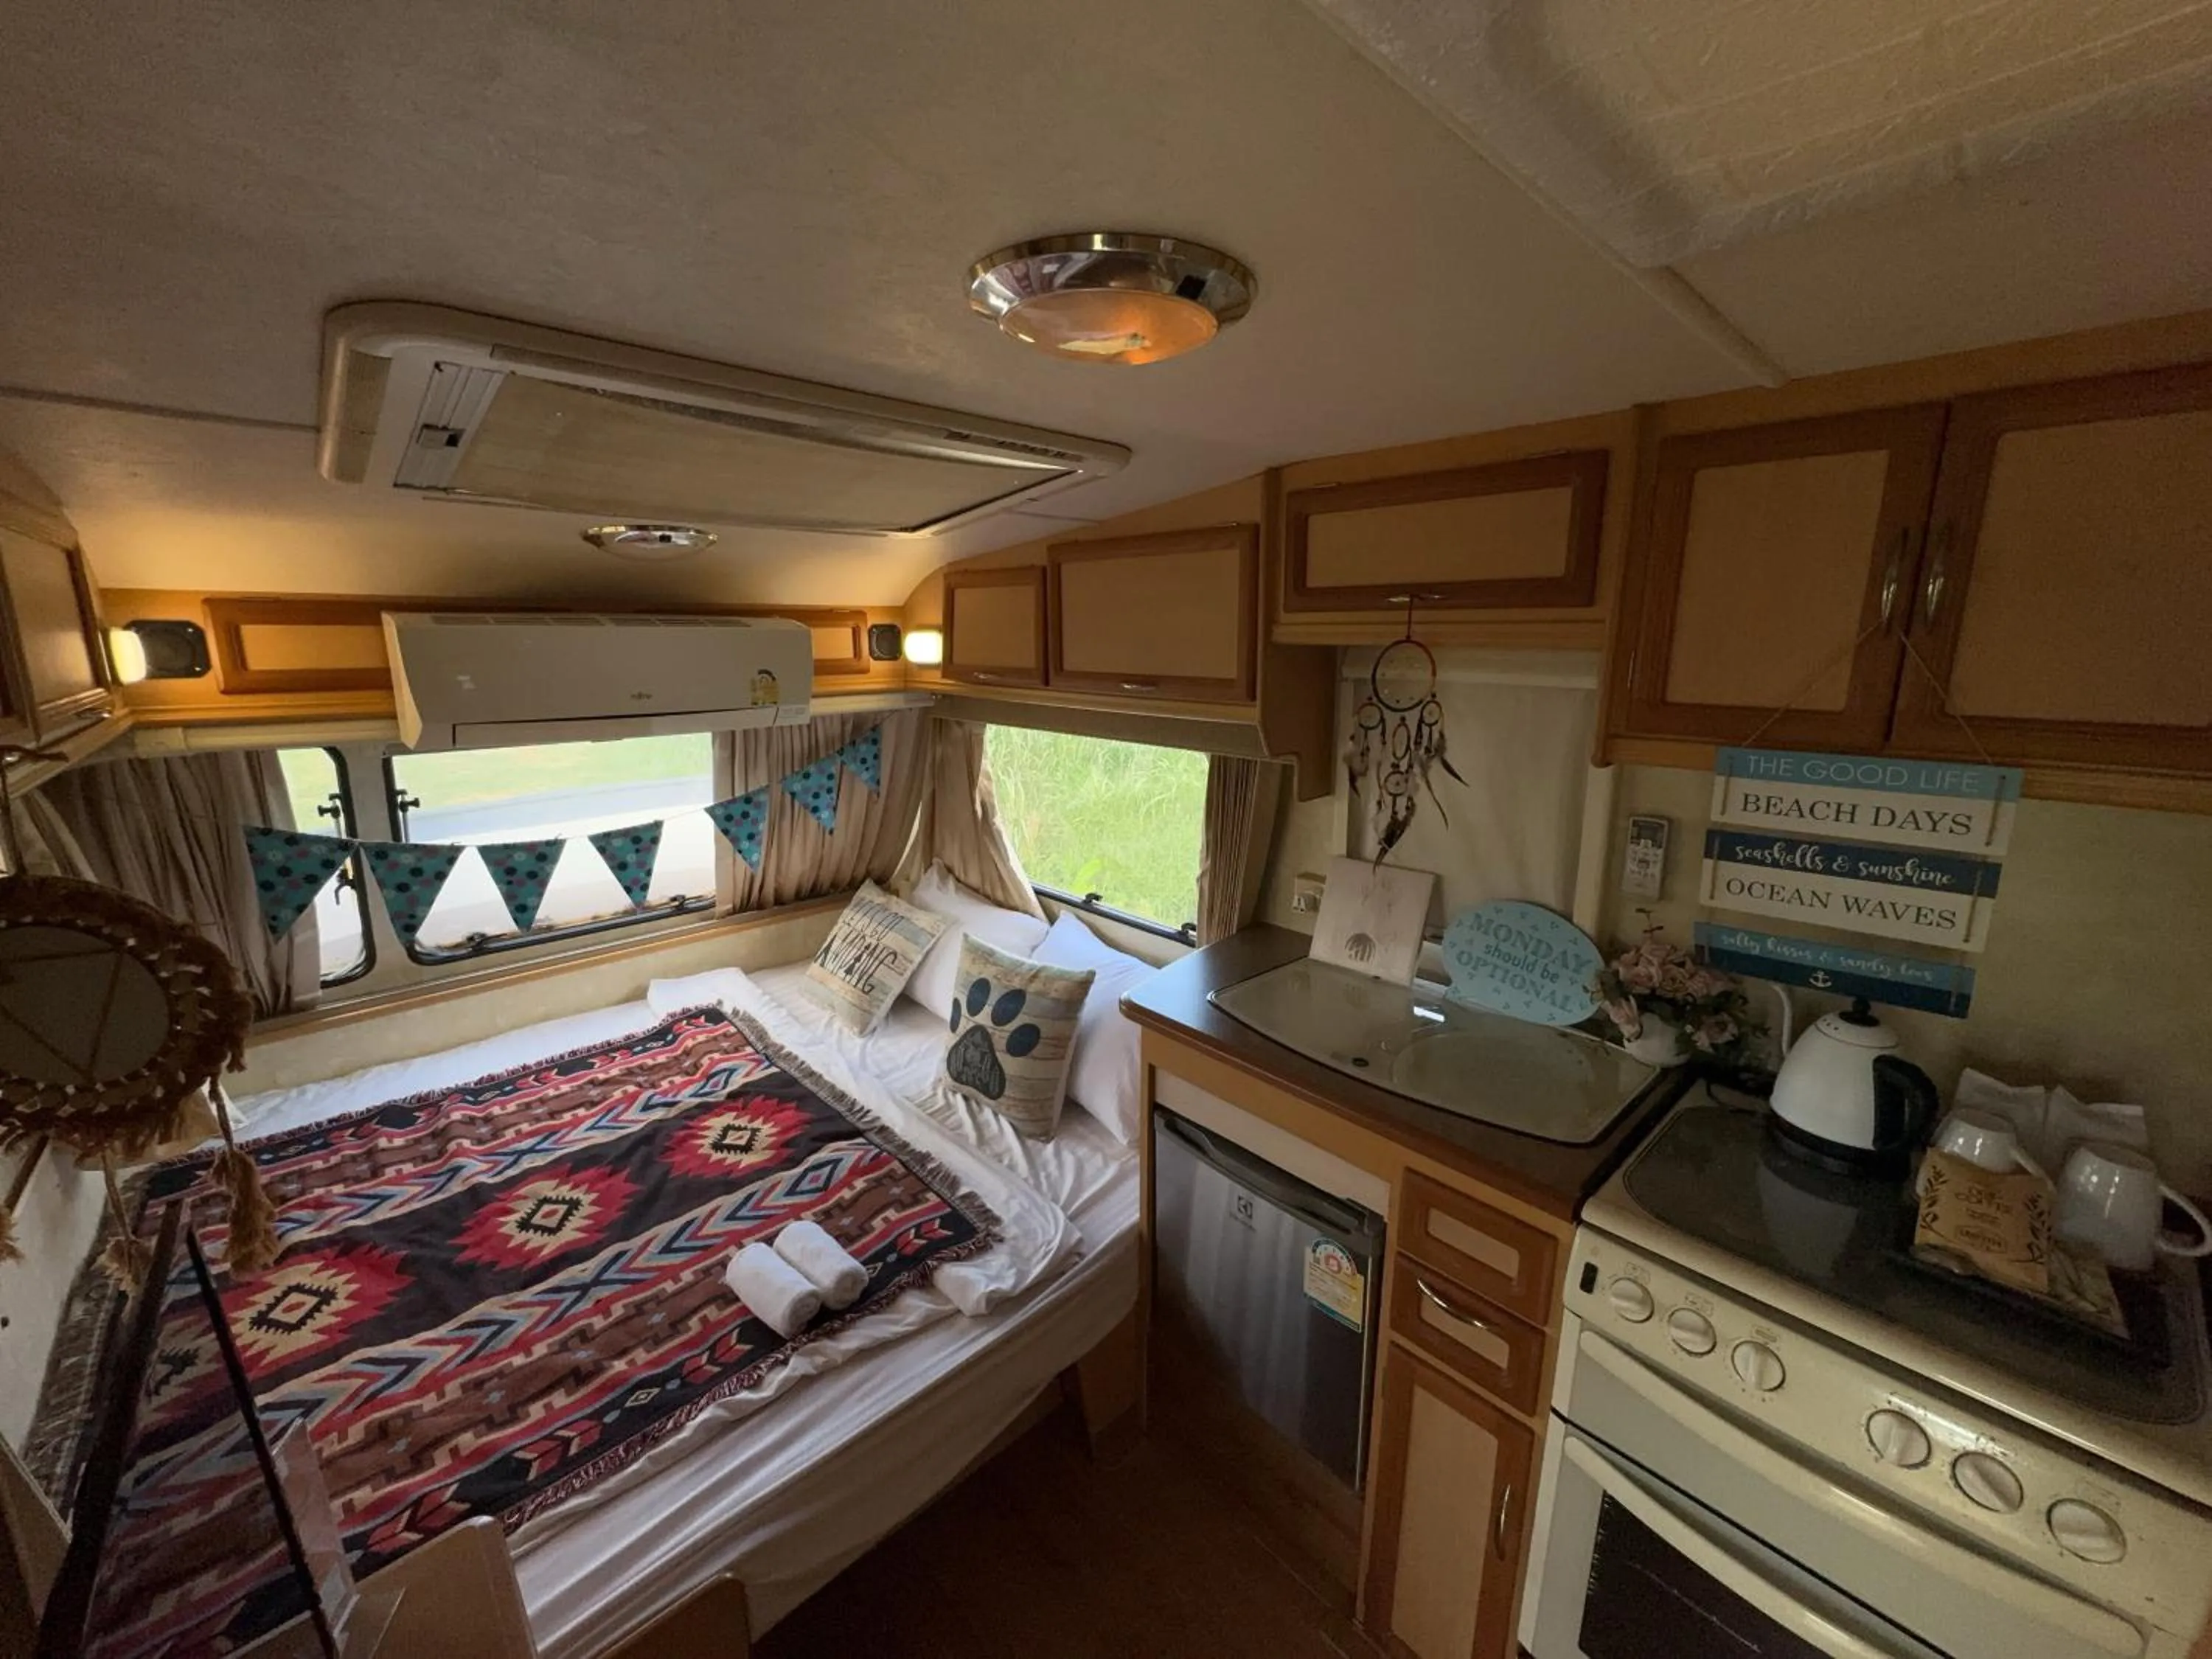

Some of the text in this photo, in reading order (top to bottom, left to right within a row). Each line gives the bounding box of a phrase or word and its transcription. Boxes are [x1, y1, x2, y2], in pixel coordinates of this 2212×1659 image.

[1747, 754, 1982, 793] THE GOOD LIFE
[1741, 792, 1973, 837] BEACH DAYS
[1735, 841, 1955, 886] seashells & sunshine
[1725, 877, 1958, 931] OCEAN WAVES
[1468, 912, 1593, 975] MONDAY
[1484, 942, 1560, 984] should be
[1456, 950, 1573, 1013] OPTIONAL
